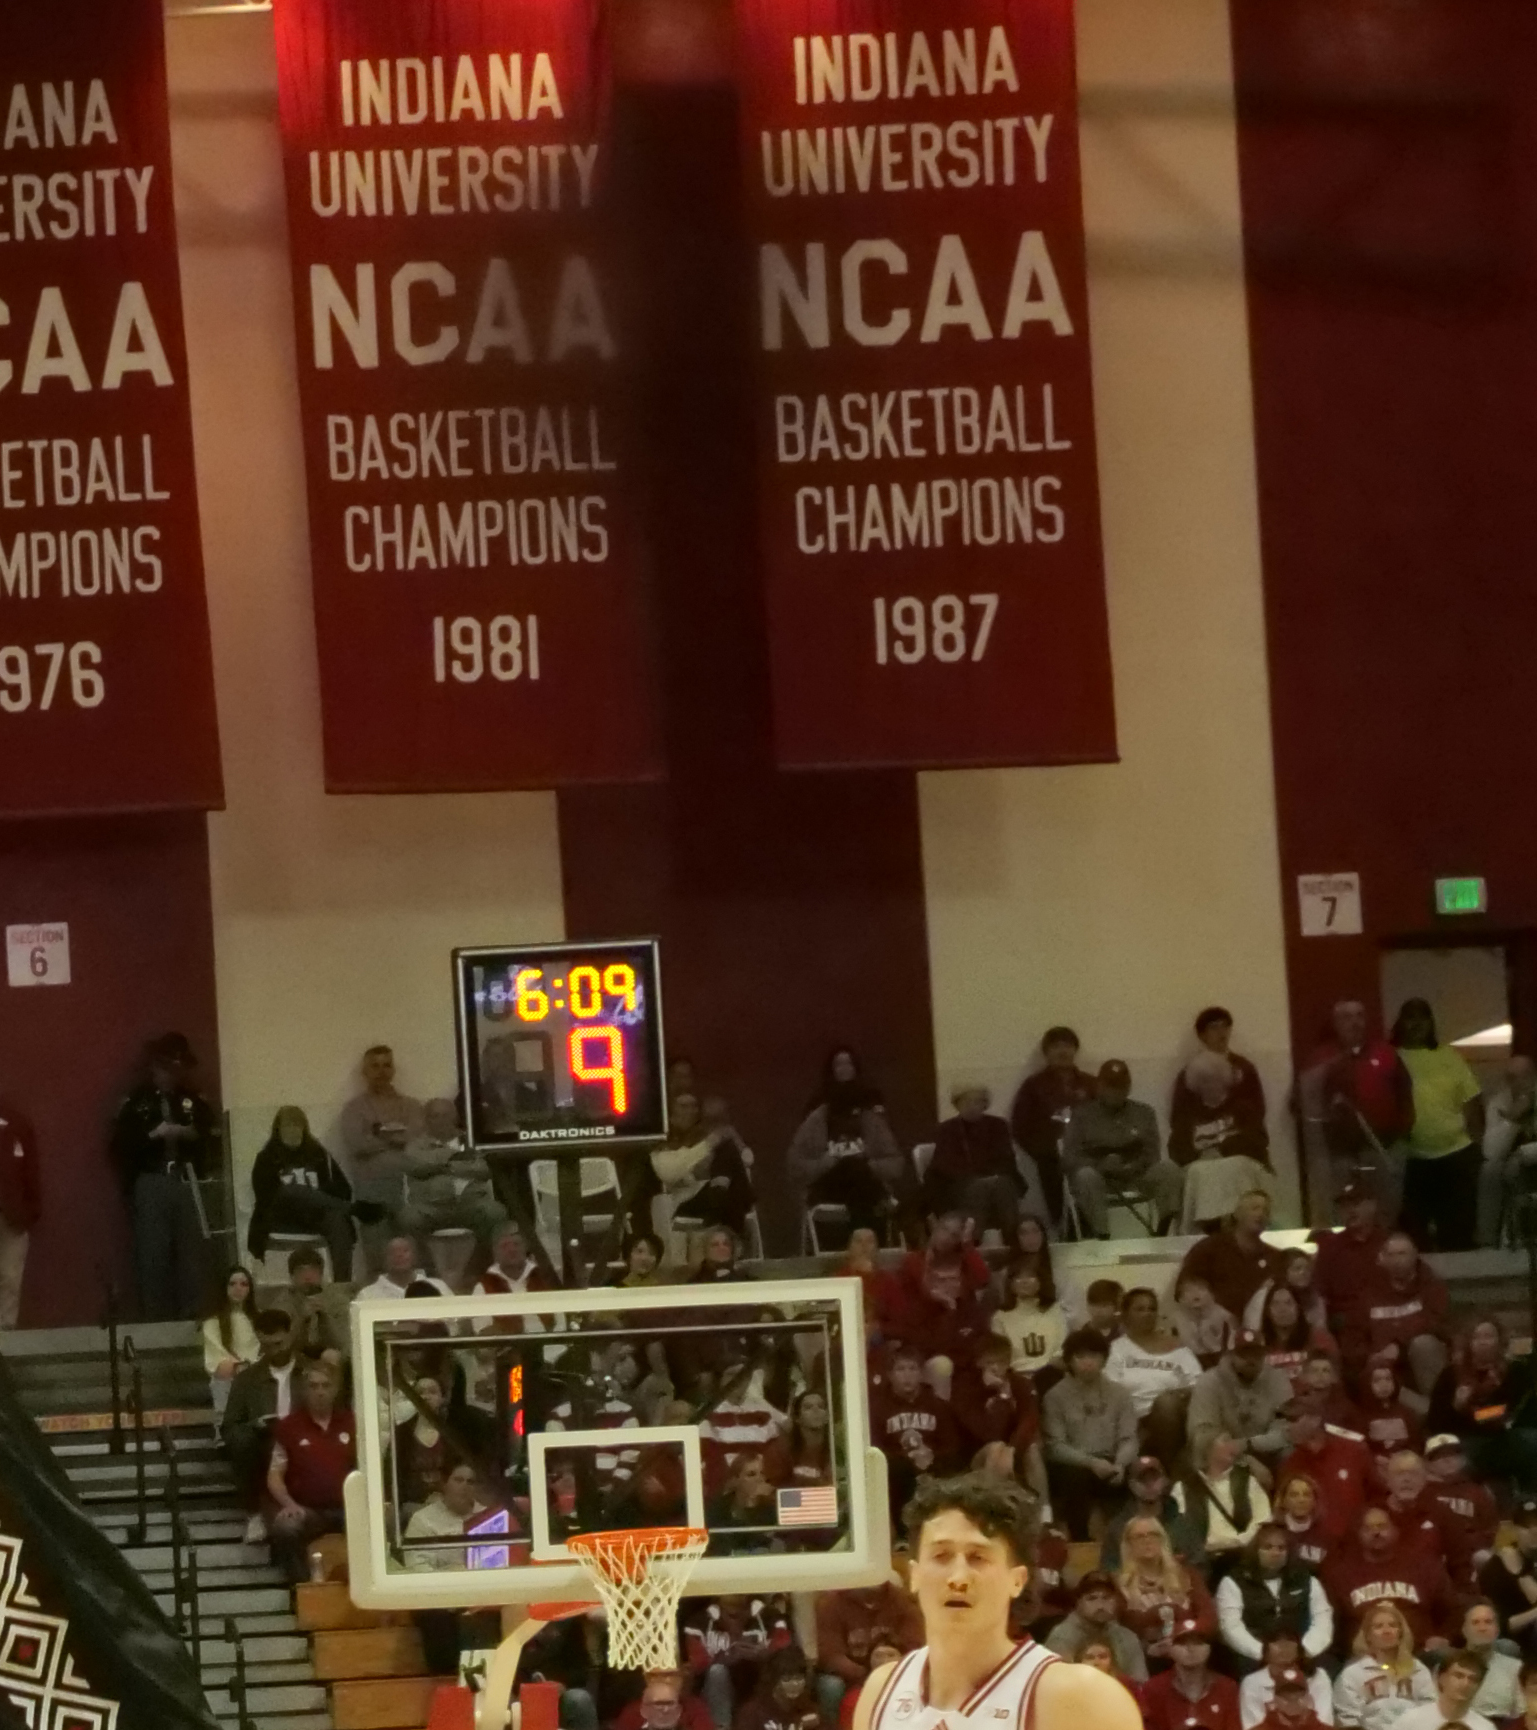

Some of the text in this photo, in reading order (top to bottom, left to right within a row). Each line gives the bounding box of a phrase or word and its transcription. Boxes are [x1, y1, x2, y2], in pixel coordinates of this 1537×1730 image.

[341, 53, 562, 126] INDIANA
[794, 27, 1018, 104] INDIANA
[309, 143, 598, 218] UNIVERSITY
[762, 115, 1053, 196] UNIVERSITY
[310, 258, 618, 370] NCAA
[762, 230, 1073, 350] NCAA
[326, 405, 616, 482] BASKETBALL
[776, 384, 1071, 463] BASKETBALL
[344, 496, 608, 573] CHAMPIONS
[795, 476, 1065, 554] CHAMPIONS
[433, 615, 540, 683] 1981
[874, 594, 998, 666] 1987
[1321, 896, 1337, 927] 7
[30, 946, 48, 977] 6
[516, 964, 636, 1021] 6:09
[569, 1025, 627, 1115] 9
[519, 1126, 616, 1141] DAKTRONICS
